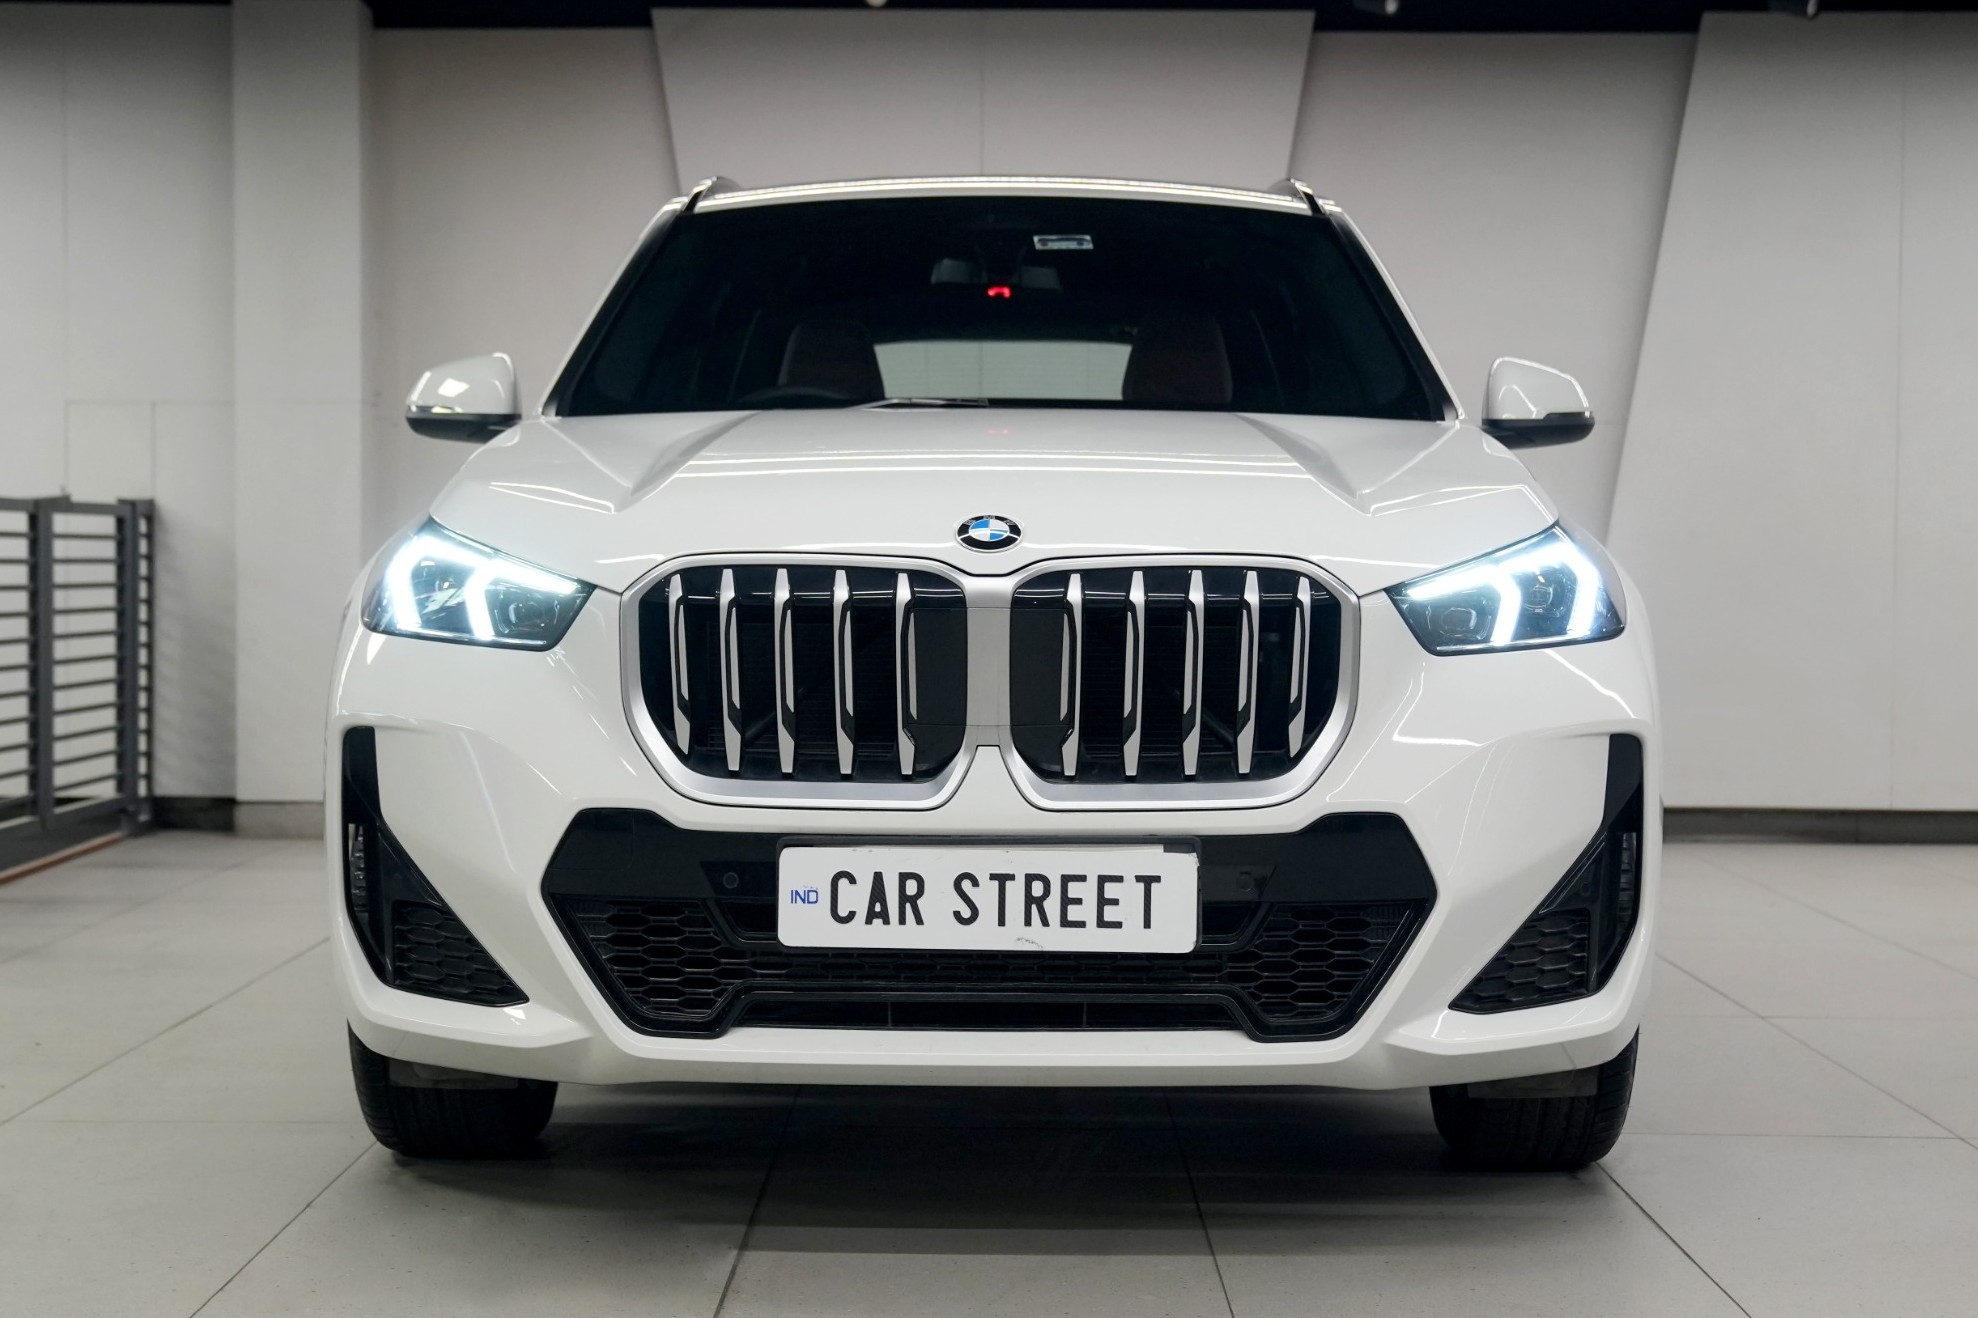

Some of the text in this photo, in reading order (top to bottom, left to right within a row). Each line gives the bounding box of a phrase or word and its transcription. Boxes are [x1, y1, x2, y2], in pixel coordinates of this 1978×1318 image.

[790, 870, 1162, 930] IND CAR STREET
